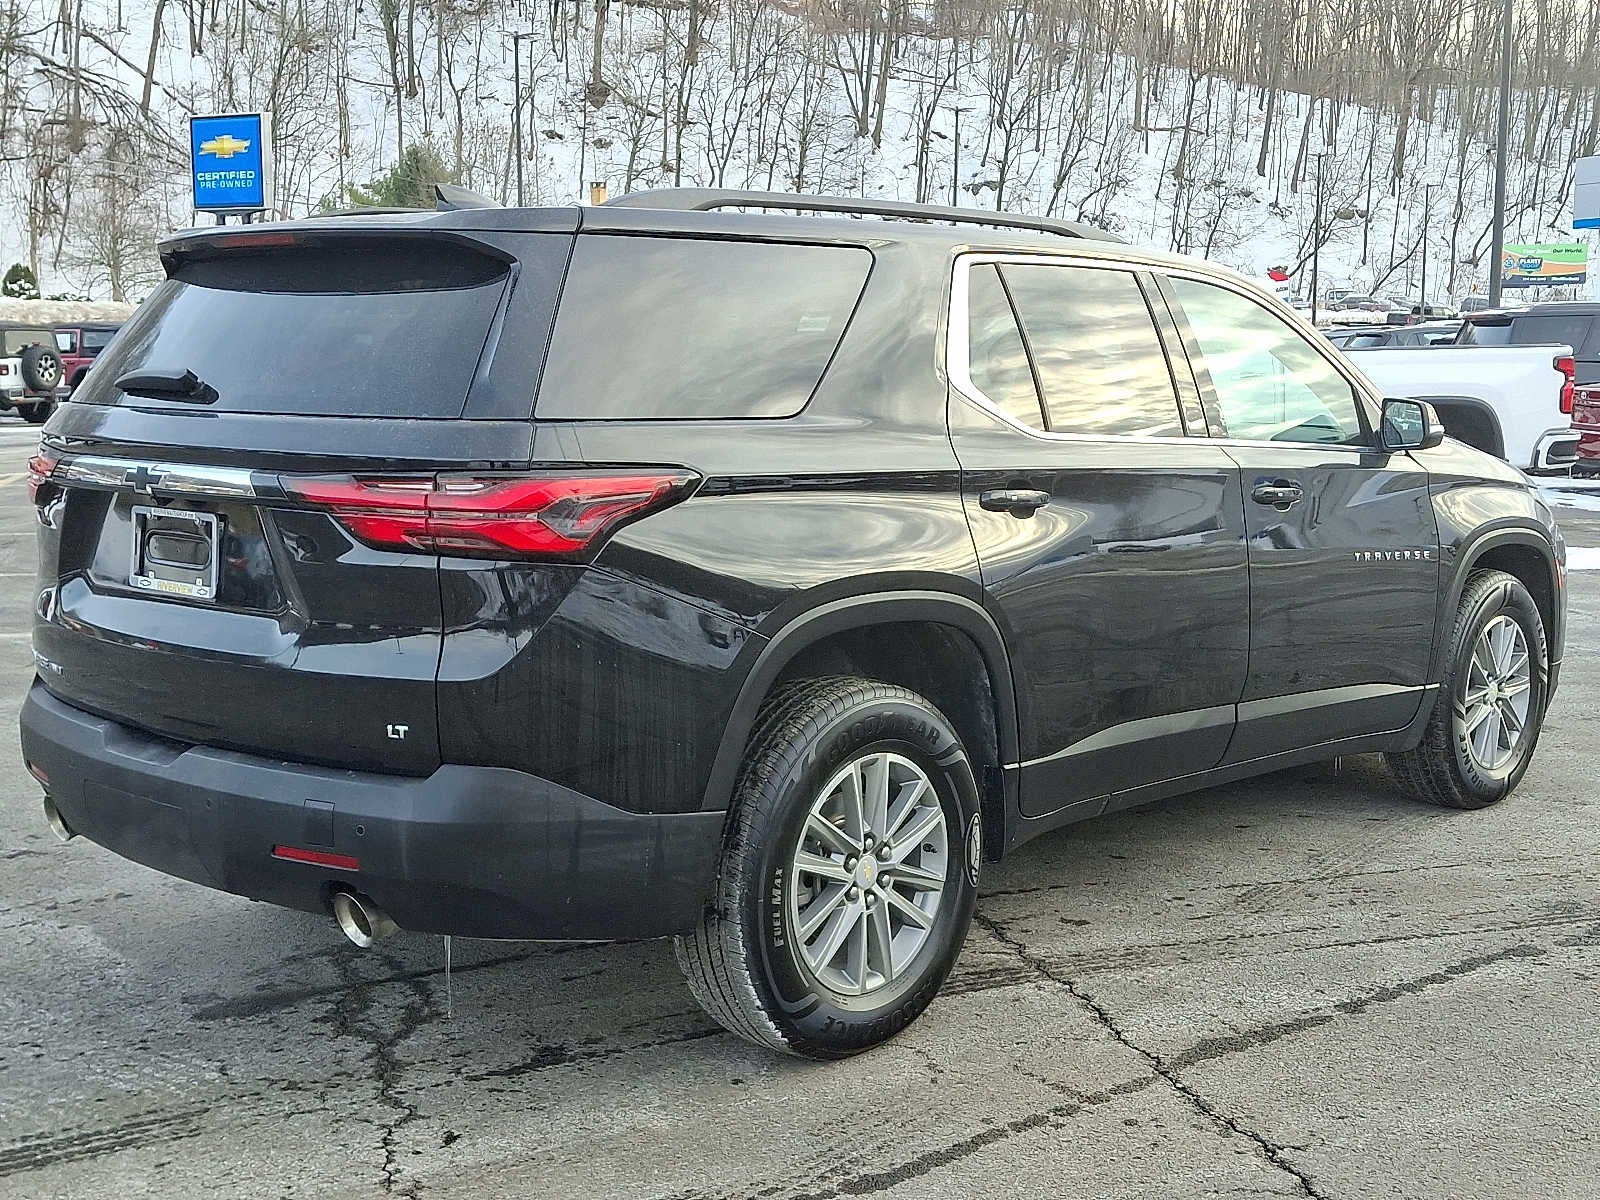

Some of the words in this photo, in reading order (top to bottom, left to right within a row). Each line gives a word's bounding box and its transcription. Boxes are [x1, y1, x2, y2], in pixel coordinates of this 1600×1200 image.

[197, 170, 255, 181] CERTIFIED
[200, 180, 253, 189] PRE-OWNED
[1354, 550, 1431, 561] TRAVERSE
[386, 724, 409, 739] LT
[830, 711, 941, 756] GOODEAR
[772, 909, 785, 947] FUEL
